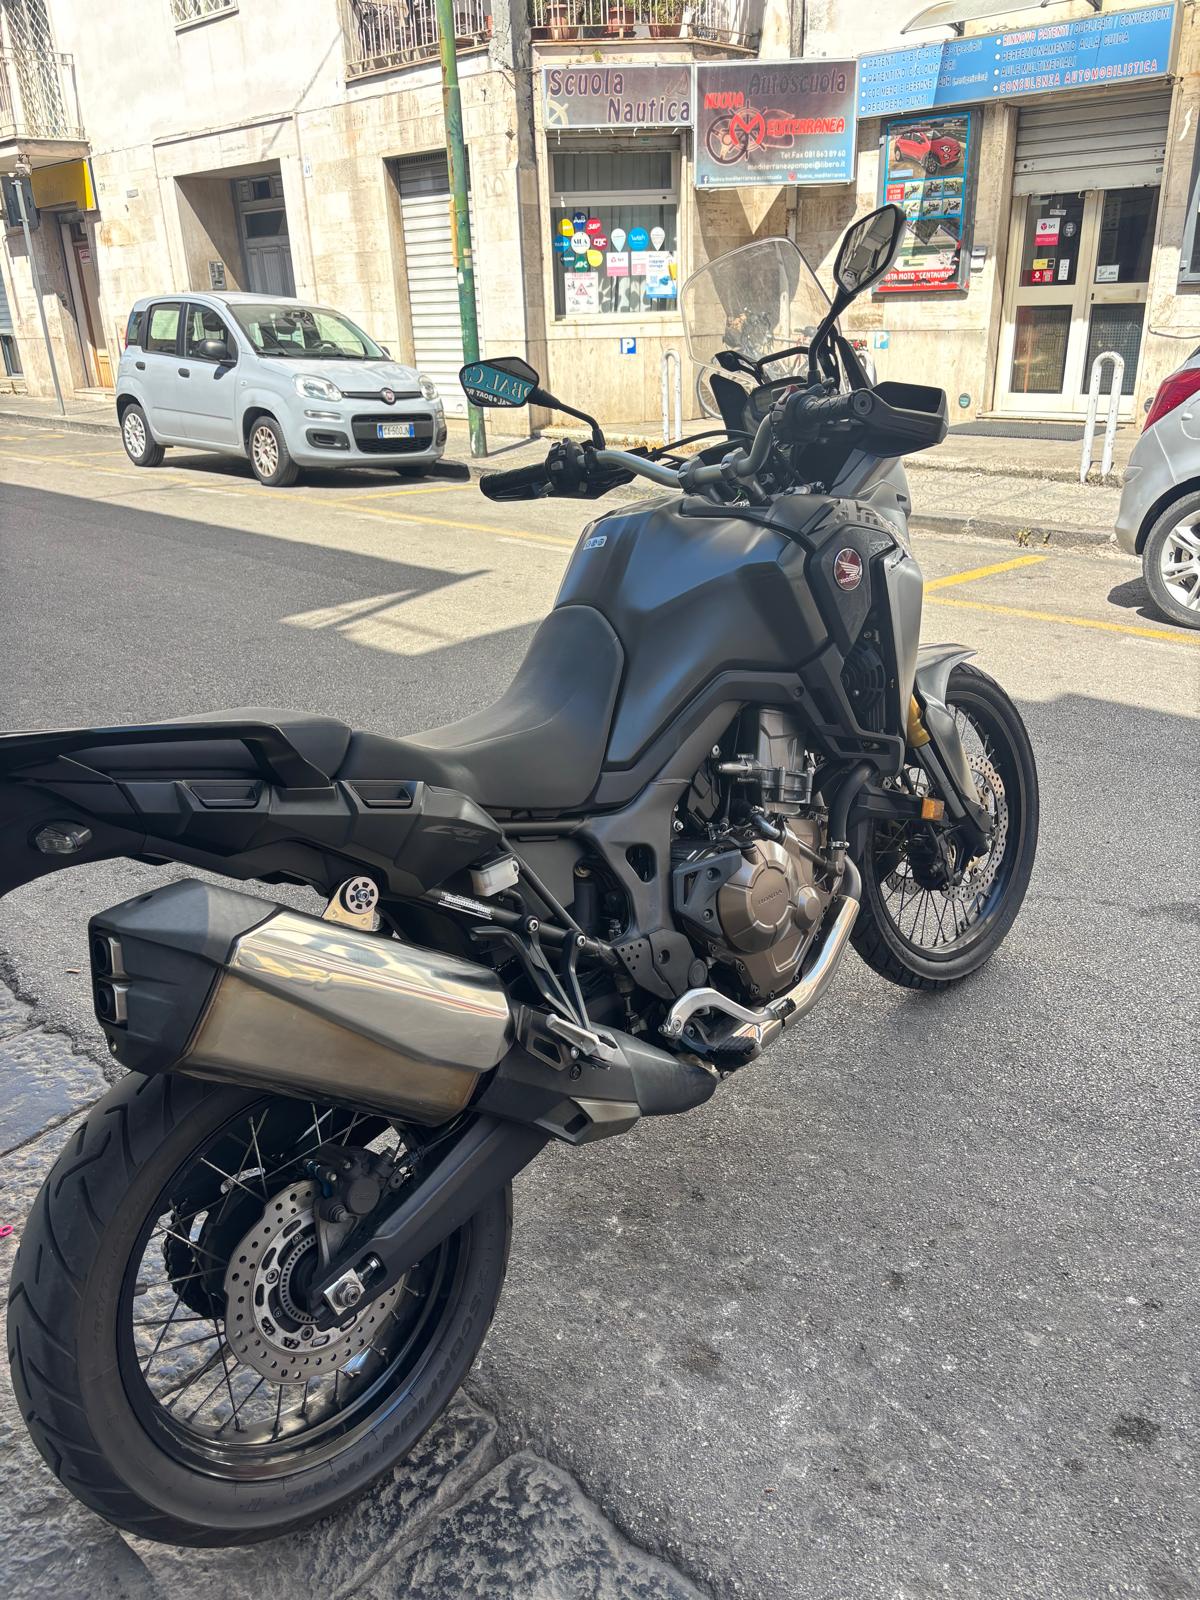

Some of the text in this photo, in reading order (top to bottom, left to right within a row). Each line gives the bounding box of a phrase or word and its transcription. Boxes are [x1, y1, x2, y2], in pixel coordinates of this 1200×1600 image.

[1002, 31, 1036, 47] RINNOVO
[1038, 24, 1070, 41] PATENTI
[1002, 40, 1076, 61] PERFEZIONAMENTO
[1078, 35, 1101, 50] ALLA
[549, 68, 624, 97] Scuola
[748, 68, 848, 96] Autoscuola
[1000, 72, 1061, 94] CONSULENZA
[1064, 58, 1158, 84] AUTOMOBILISTICA
[1001, 64, 1020, 77] AULE
[607, 97, 691, 124] Nautica
[898, 272, 916, 280] MOTO
[758, 888, 784, 906] HONDA
